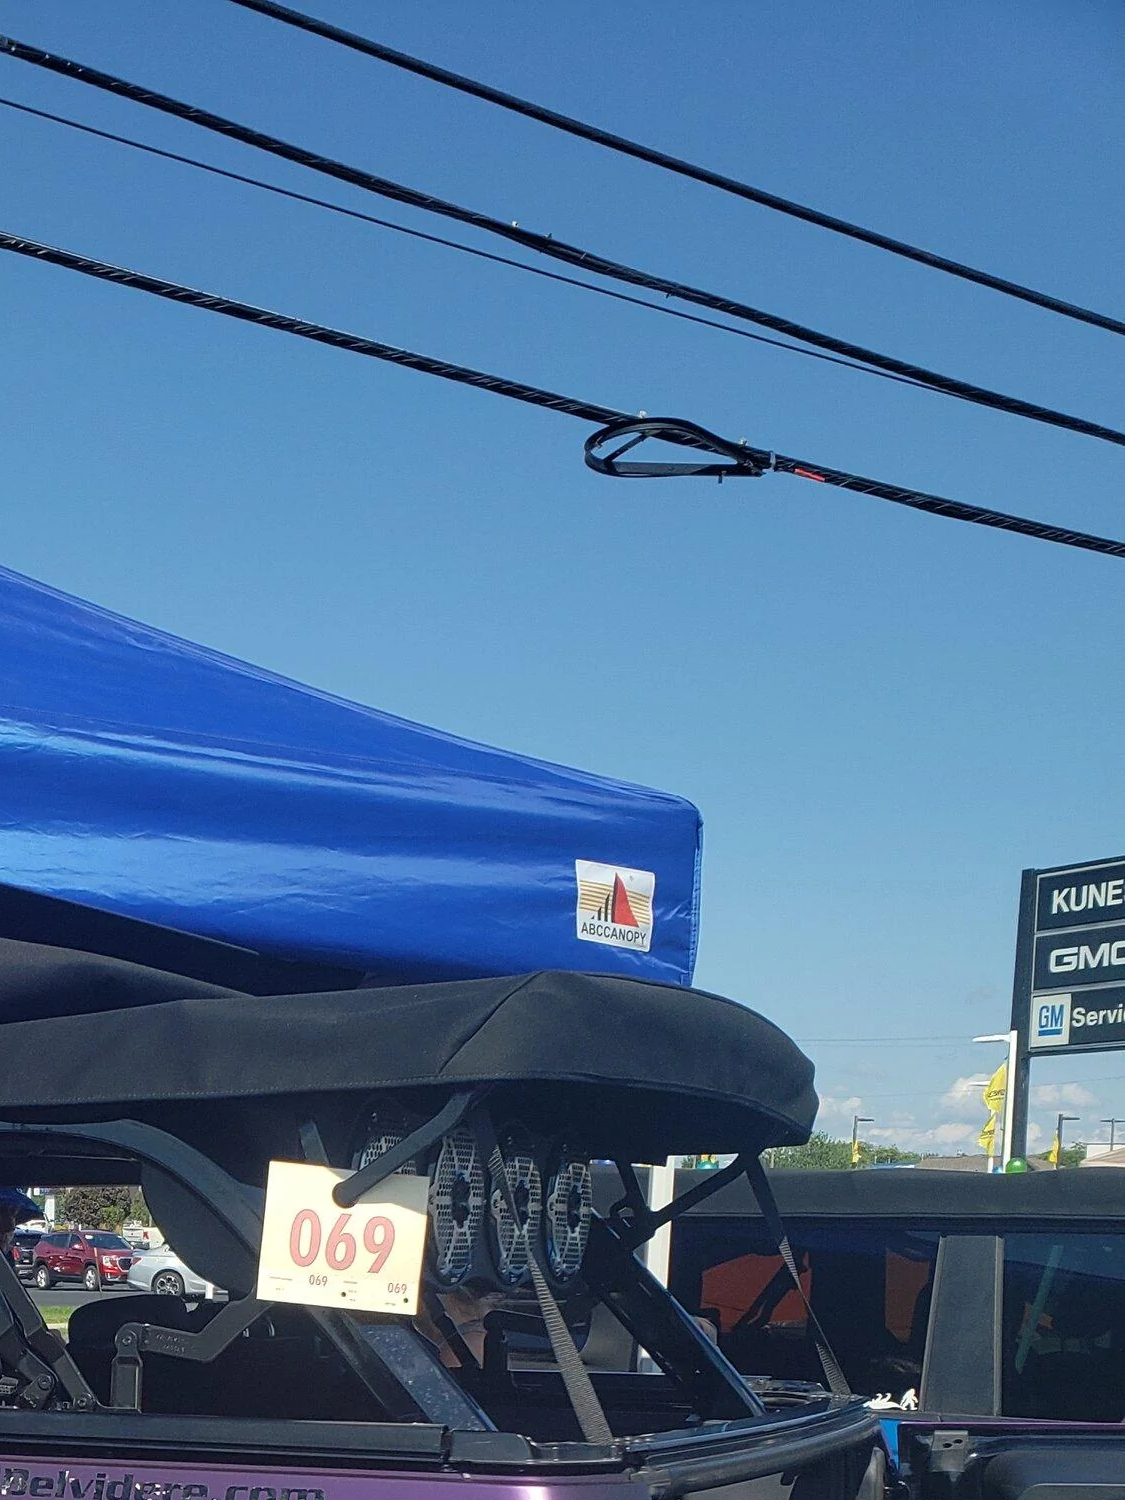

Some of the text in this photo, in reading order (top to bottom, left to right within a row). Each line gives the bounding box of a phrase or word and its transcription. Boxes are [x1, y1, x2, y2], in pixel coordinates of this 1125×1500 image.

[1051, 879, 1125, 914] KUNE
[581, 922, 647, 945] ABCCANOPY
[1038, 1003, 1125, 1030] GM Servi
[289, 1208, 396, 1274] 069
[308, 1274, 328, 1287] 069
[387, 1282, 408, 1295] 069
